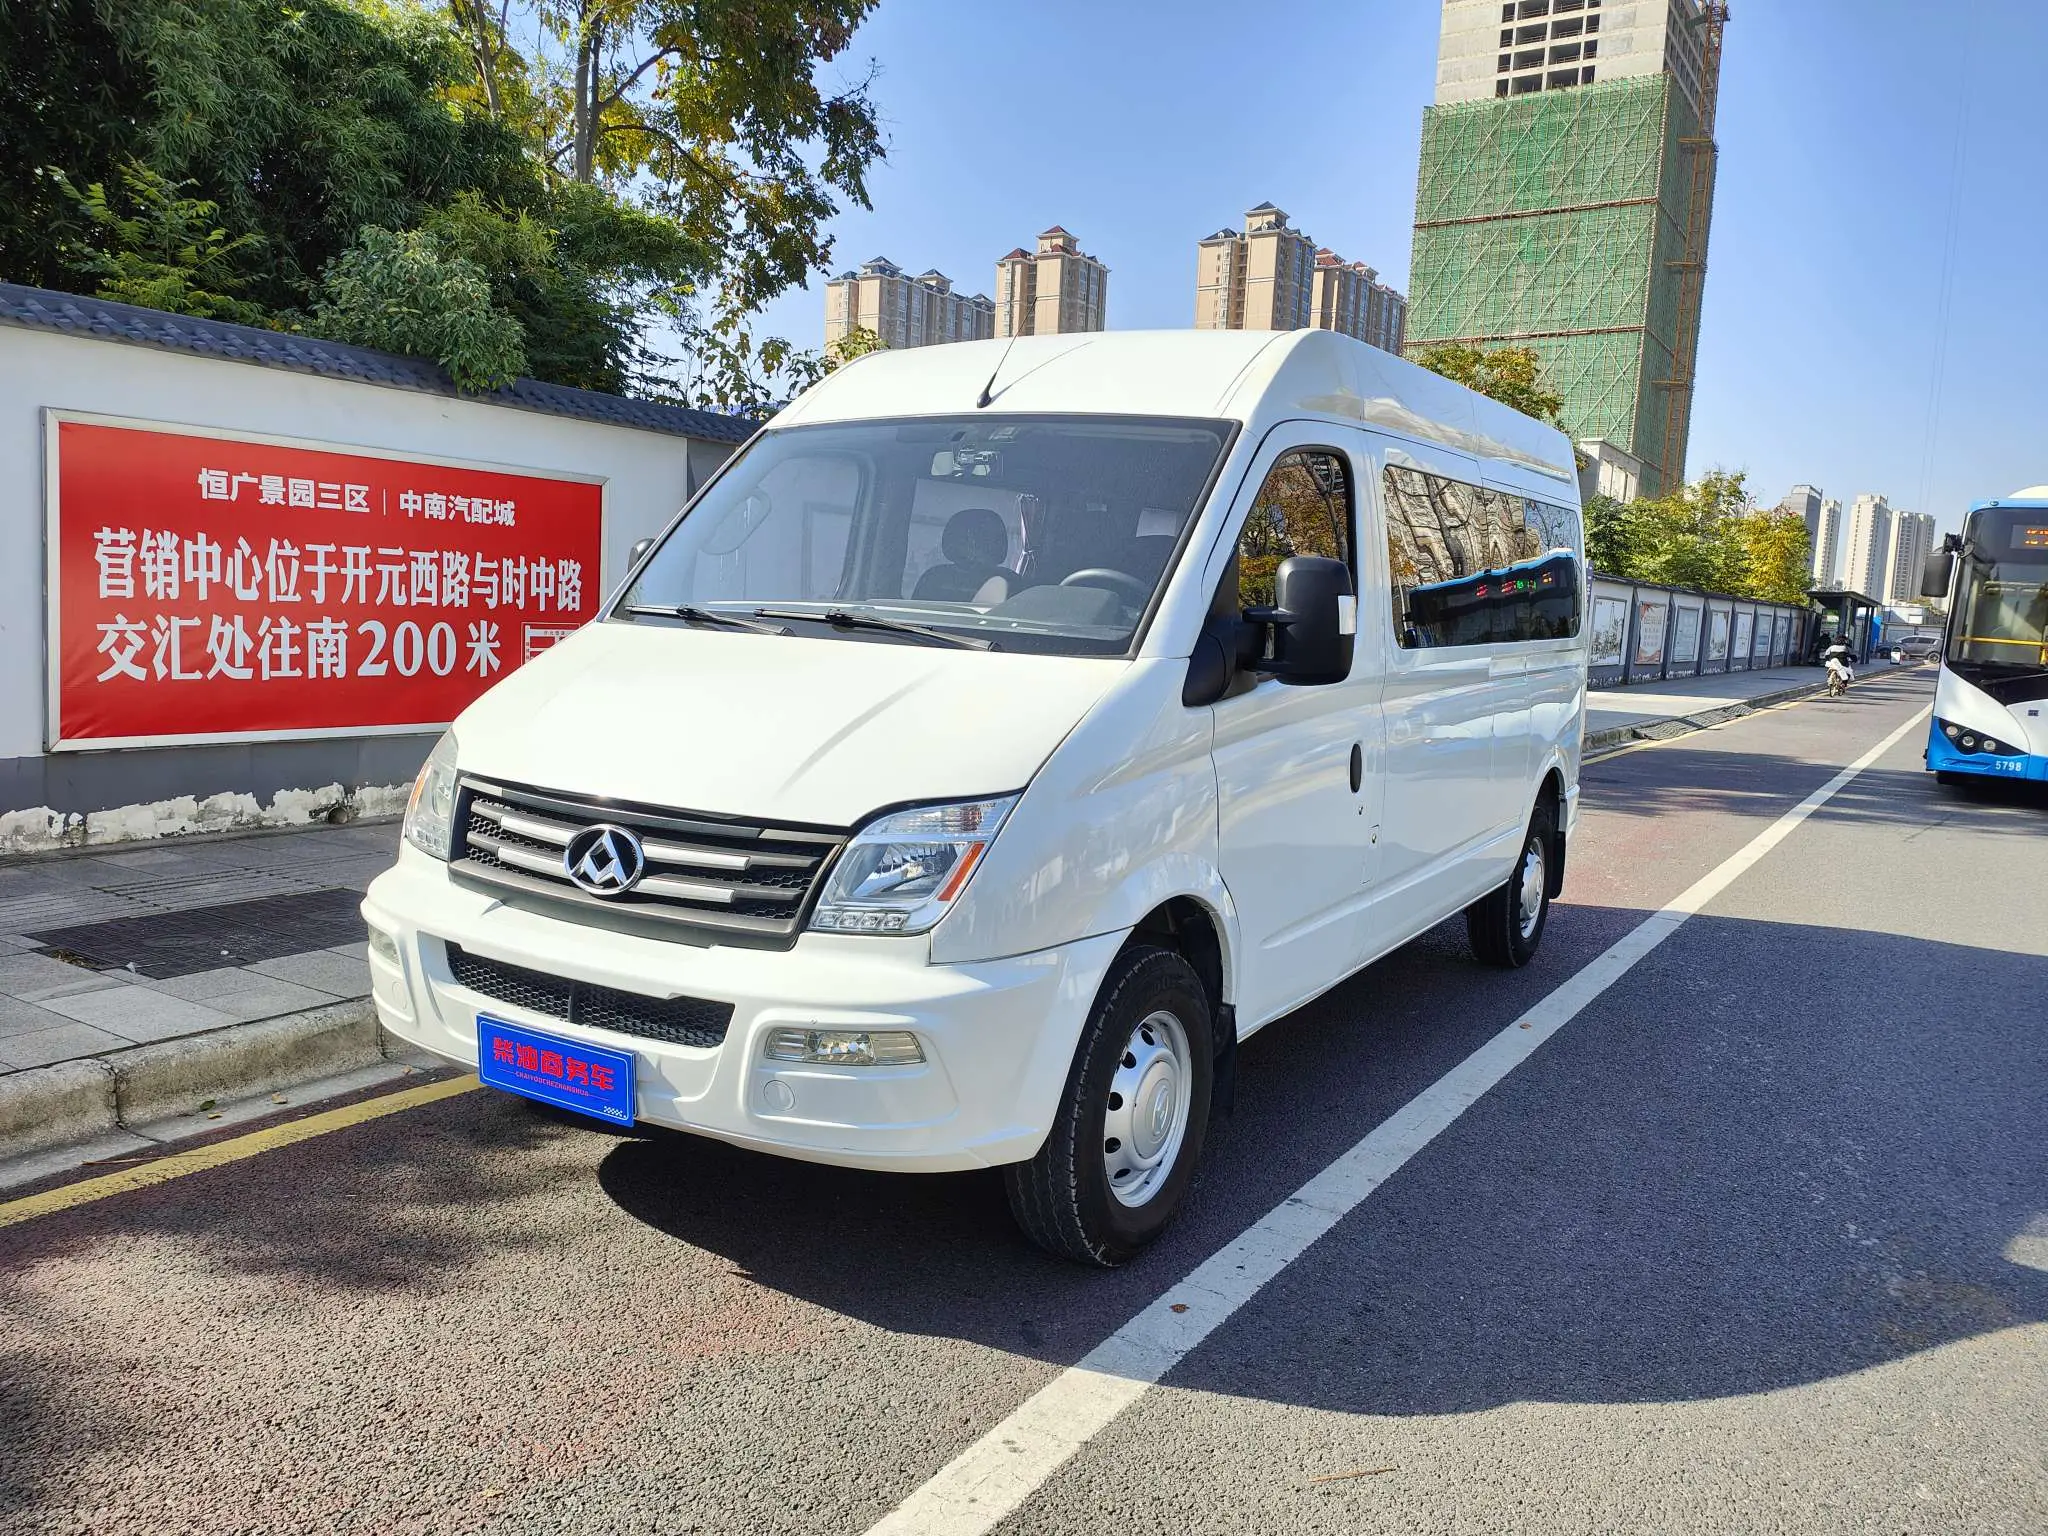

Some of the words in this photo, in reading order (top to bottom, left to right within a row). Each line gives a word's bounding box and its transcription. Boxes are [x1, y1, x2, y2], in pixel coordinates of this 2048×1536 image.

[198, 467, 370, 514] 恒广景园三区
[399, 490, 516, 527] 中南汽配城
[93, 526, 583, 612] 营销中心位于开元西路与时中路
[96, 613, 501, 683] 交汇处往南200米
[1995, 760, 2022, 772] 5798
[493, 1036, 615, 1091] 柴油商务车
